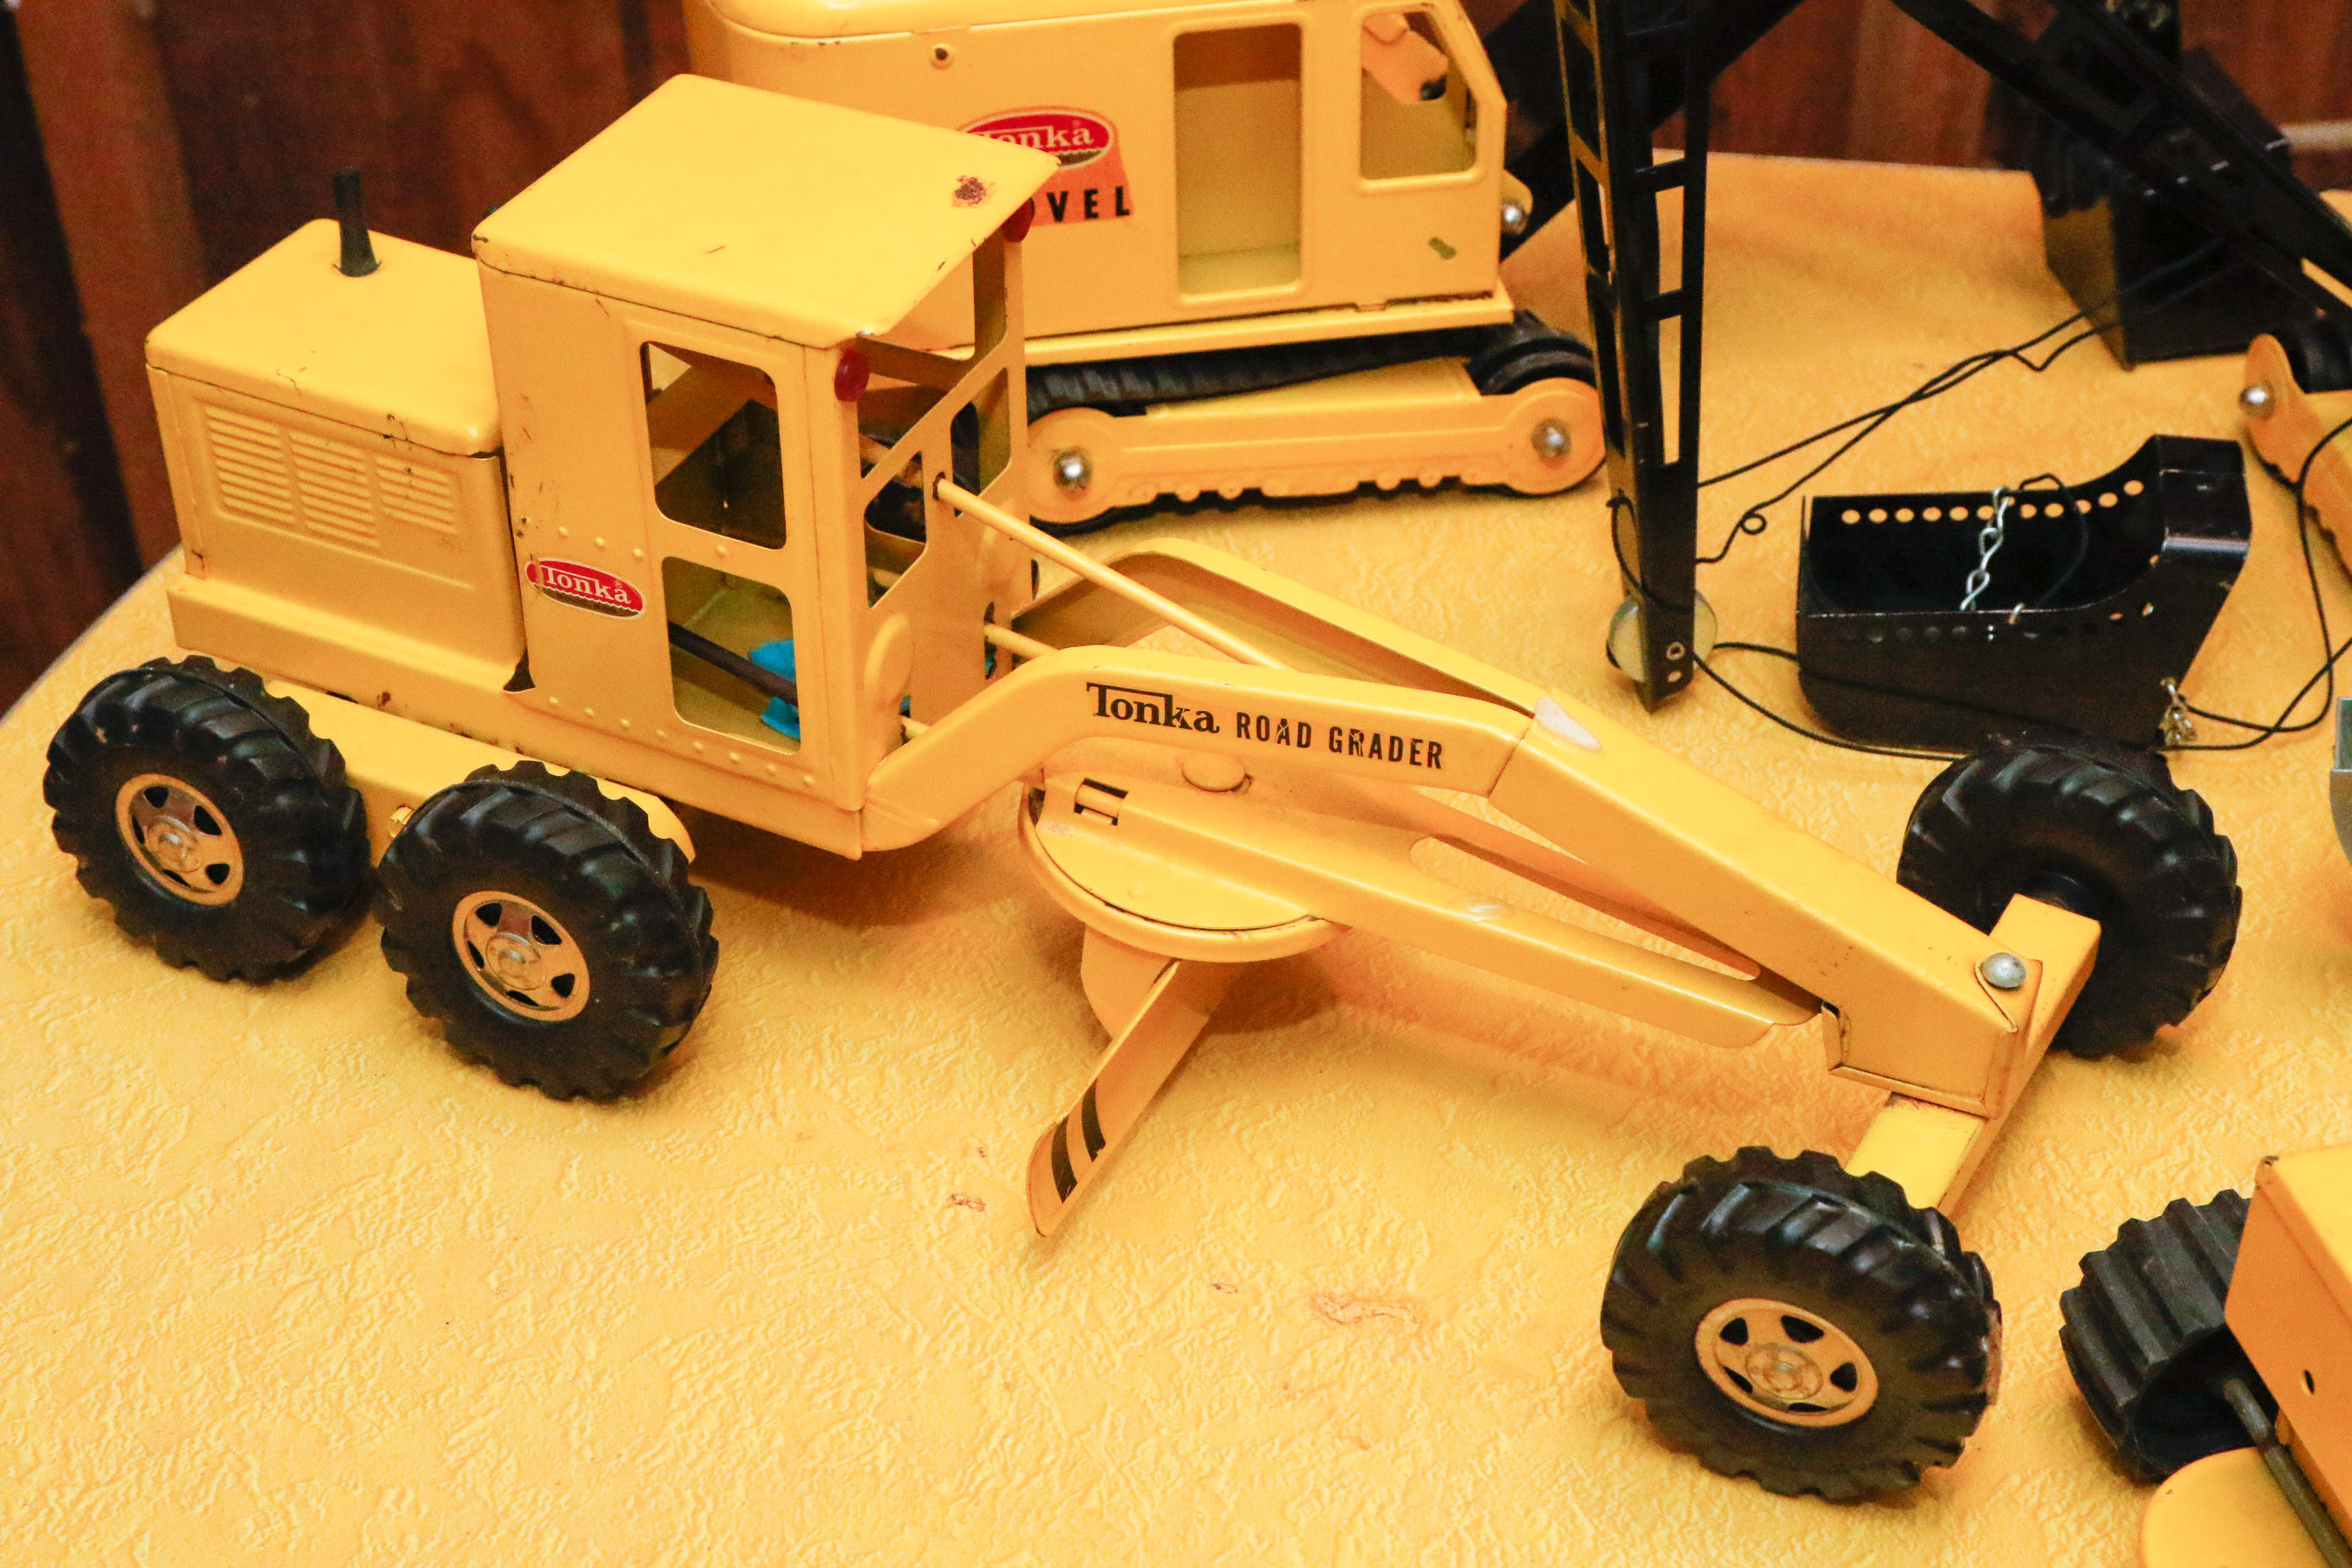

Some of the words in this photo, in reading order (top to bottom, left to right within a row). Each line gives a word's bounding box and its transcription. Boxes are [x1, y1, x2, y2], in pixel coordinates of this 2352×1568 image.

[1032, 185, 1130, 222] VEL
[541, 564, 632, 604] Tonka
[1086, 682, 1221, 734] Tonka
[1236, 711, 1313, 749] ROAD
[1328, 726, 1444, 769] GRADER
